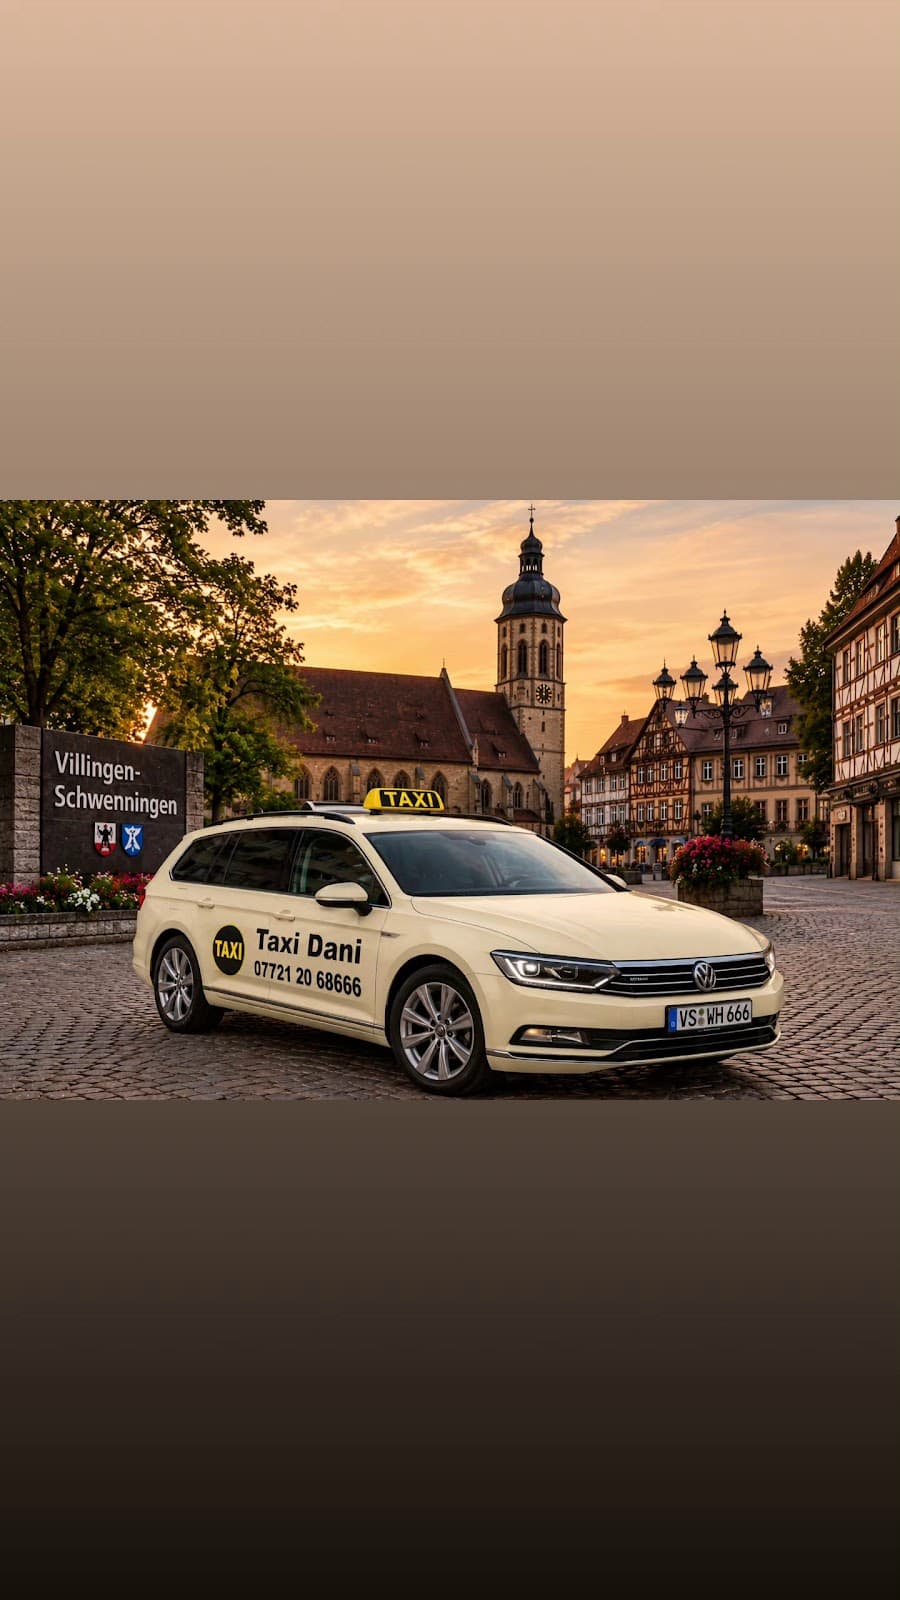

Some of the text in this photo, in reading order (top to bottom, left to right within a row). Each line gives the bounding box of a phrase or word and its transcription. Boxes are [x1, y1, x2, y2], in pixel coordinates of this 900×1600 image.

[54, 750, 141, 784] Villingen-
[54, 785, 177, 818] Schwenningen
[384, 791, 434, 807] TAXI
[215, 939, 243, 961] TAXI
[256, 928, 362, 964] Taxi Dani
[254, 960, 362, 997] 07721 20 68666
[680, 1003, 750, 1028] VS WH 666
